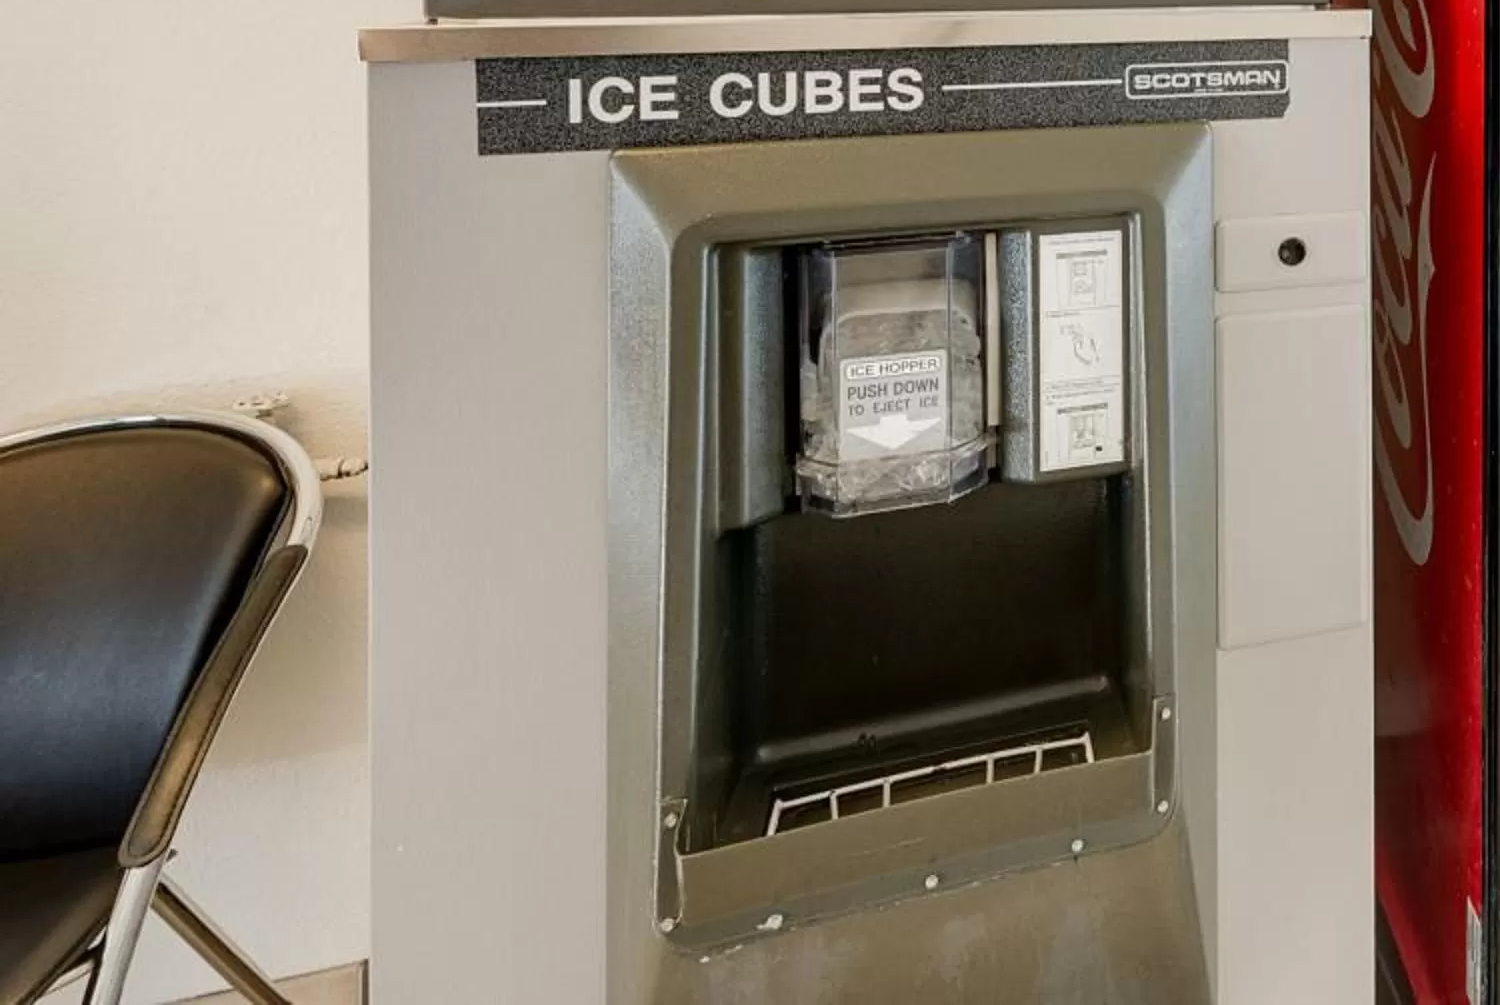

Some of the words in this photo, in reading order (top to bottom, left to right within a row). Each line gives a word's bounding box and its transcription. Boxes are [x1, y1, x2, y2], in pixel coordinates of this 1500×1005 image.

[1133, 69, 1281, 91] SCOTSMAN
[568, 76, 679, 124] ICE
[709, 67, 925, 118] CUBES
[849, 365, 876, 377] ICE
[879, 358, 938, 375] HOPPER
[847, 383, 888, 402] PUSH
[893, 377, 939, 396] DOWN
[849, 404, 865, 416] TO
[873, 398, 911, 413] EJECT
[919, 395, 939, 408] ICE
